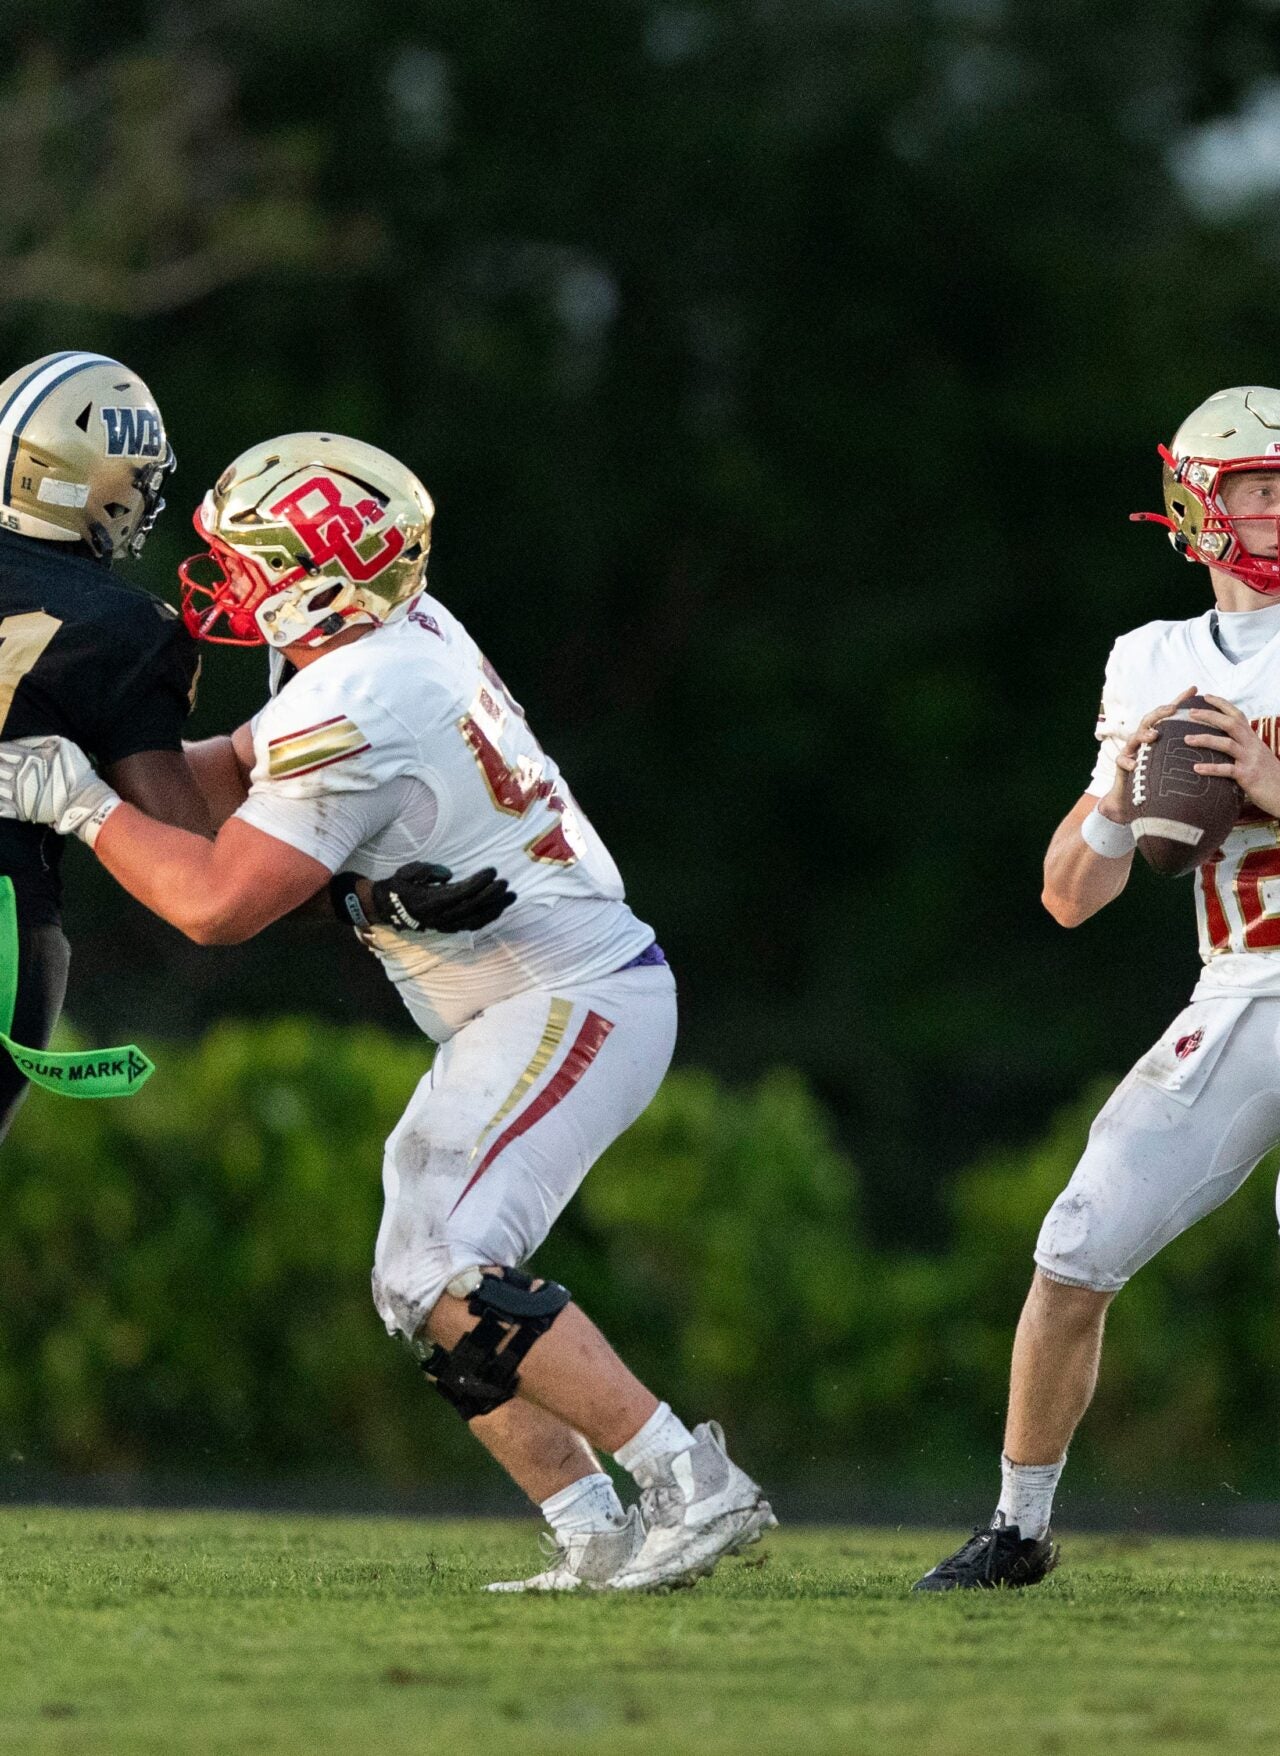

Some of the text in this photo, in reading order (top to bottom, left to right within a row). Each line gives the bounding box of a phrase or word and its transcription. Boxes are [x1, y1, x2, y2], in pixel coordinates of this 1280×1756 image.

[101, 406, 165, 458] WB
[270, 477, 406, 583] BC
[14, 1054, 125, 1081] OUR MARK
